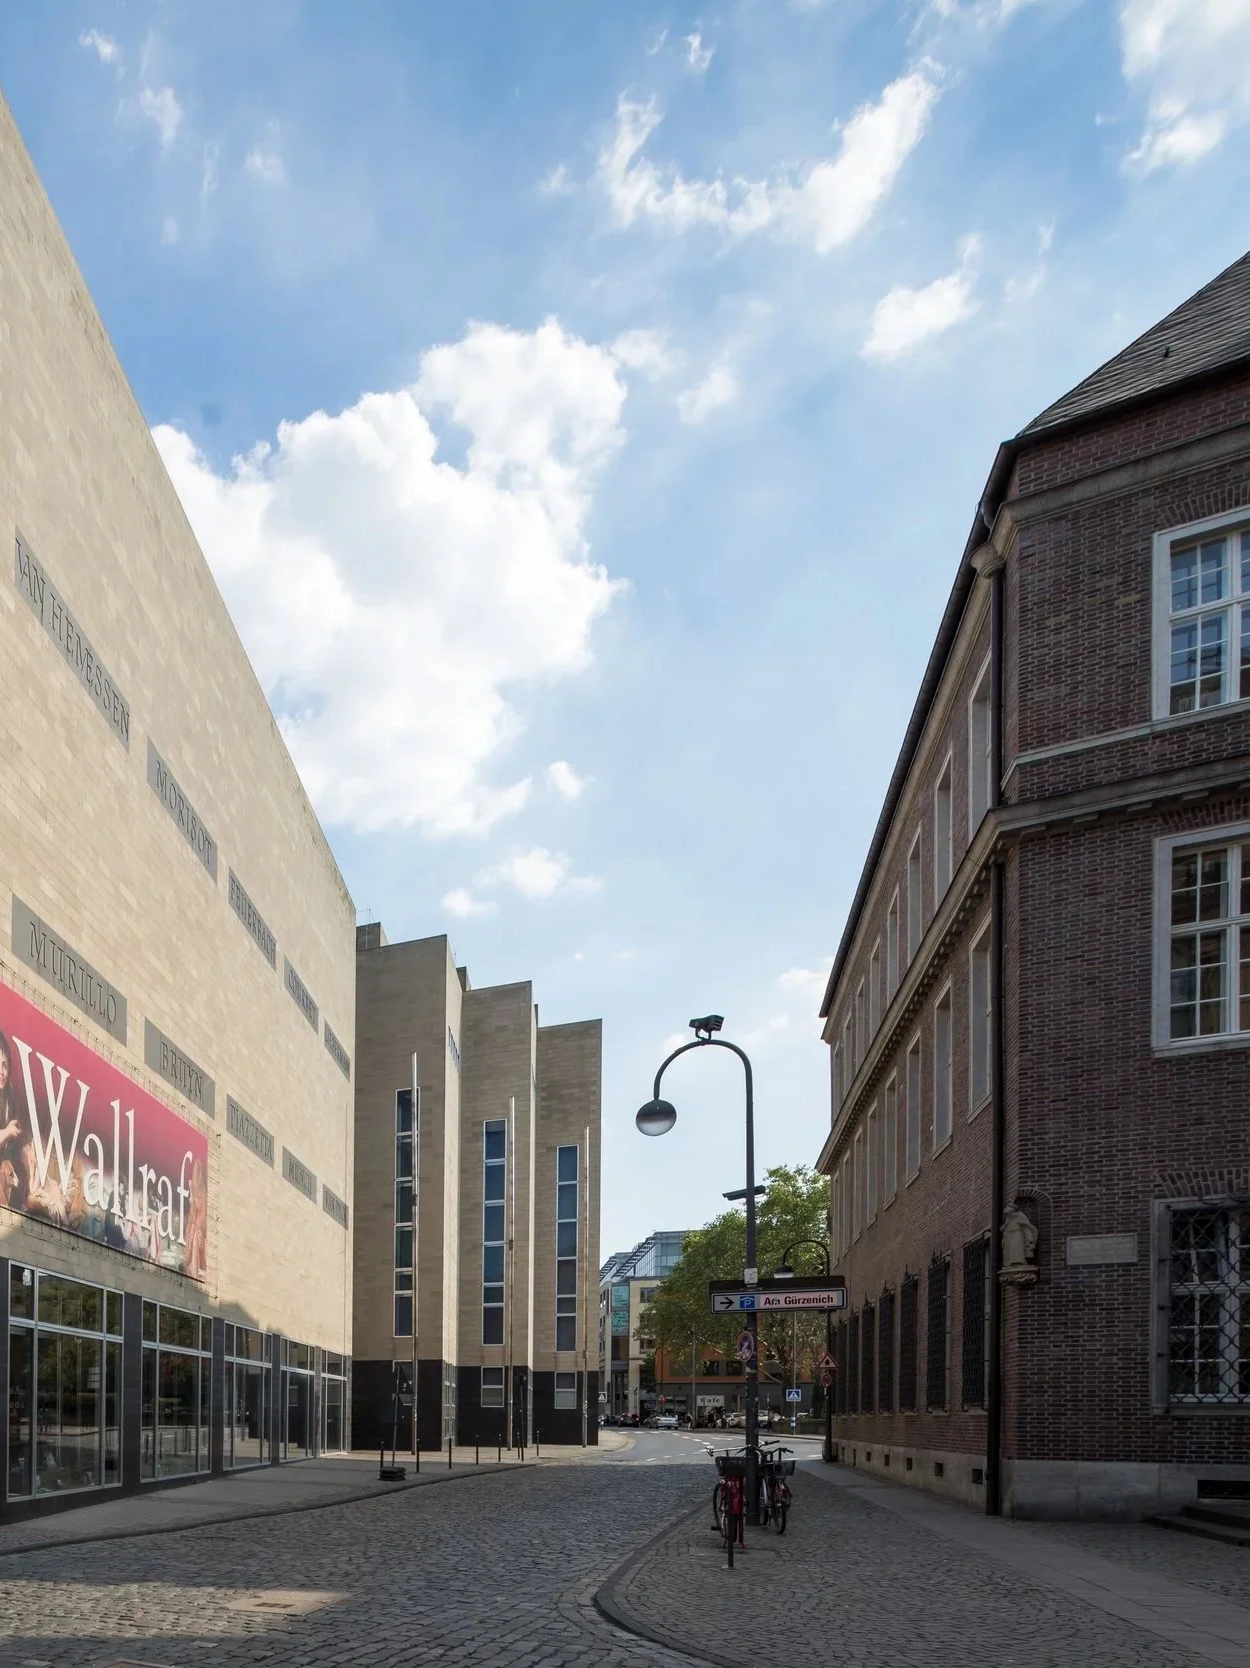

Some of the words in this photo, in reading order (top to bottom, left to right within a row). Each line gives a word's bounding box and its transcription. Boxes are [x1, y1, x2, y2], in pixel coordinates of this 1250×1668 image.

[15, 537, 47, 618] VAN
[49, 592, 130, 741] HEMESSEN
[156, 759, 213, 866] MORISOT
[229, 874, 276, 965] FEUERBACH
[28, 921, 118, 1030] MURILLO
[288, 968, 317, 1026] COURBET
[160, 1041, 204, 1099] BRUYN
[12, 1035, 194, 1247] Wallraf
[230, 1103, 273, 1161] PIAZZETTA
[784, 1294, 834, 1306] Gürzenich
